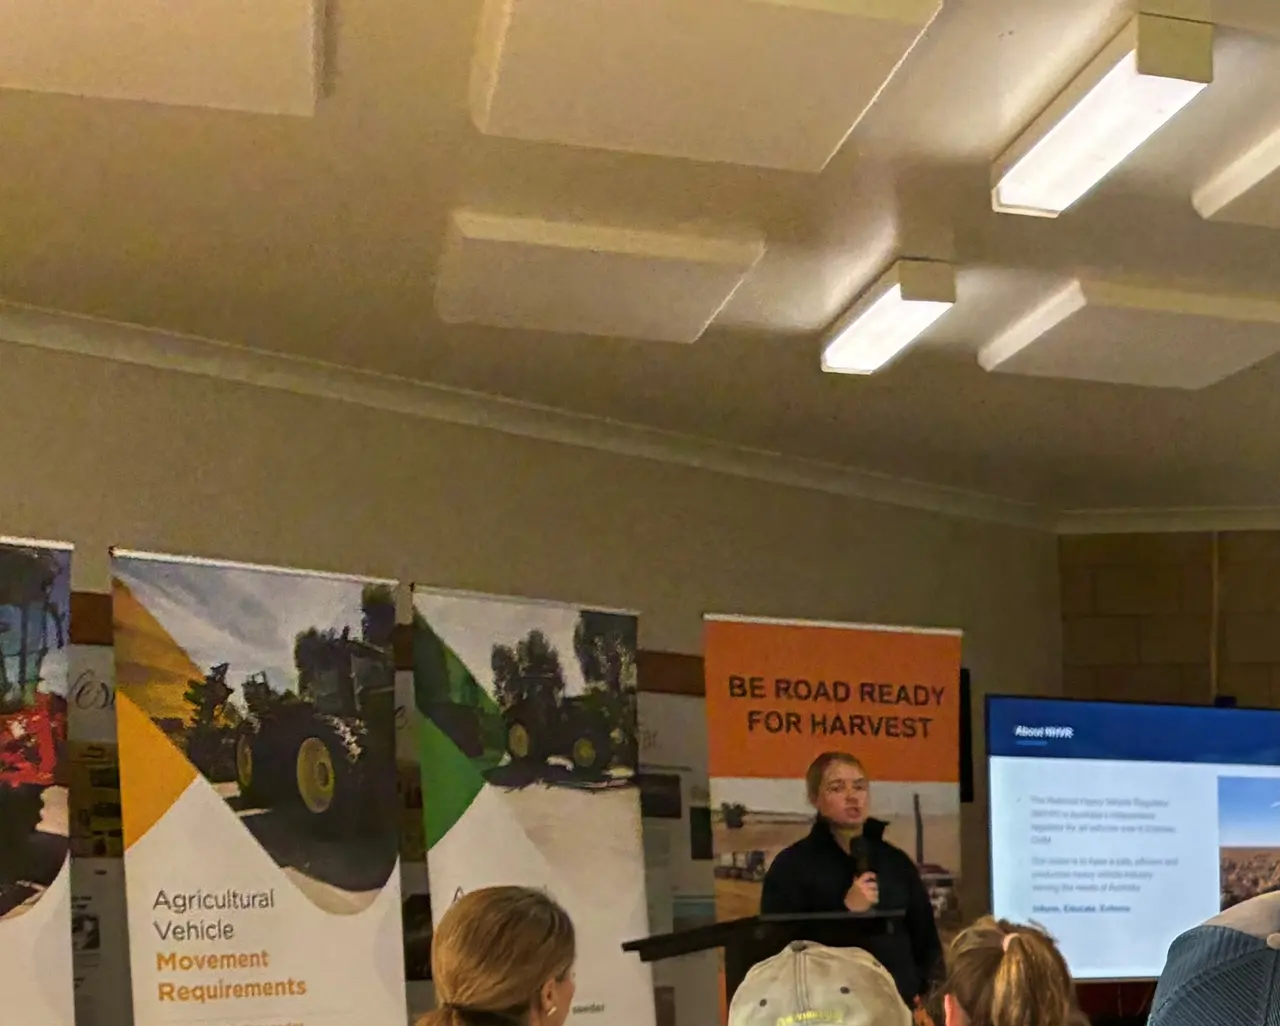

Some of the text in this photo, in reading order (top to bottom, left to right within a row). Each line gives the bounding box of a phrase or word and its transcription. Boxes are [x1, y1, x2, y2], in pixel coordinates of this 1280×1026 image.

[729, 676, 946, 707] BE ROAD READY
[747, 711, 934, 738] FOR HARVEST
[152, 888, 275, 914] Agricultural
[152, 918, 235, 941] Vehicle
[156, 950, 270, 972] Movement
[158, 977, 307, 1005] Requirements
